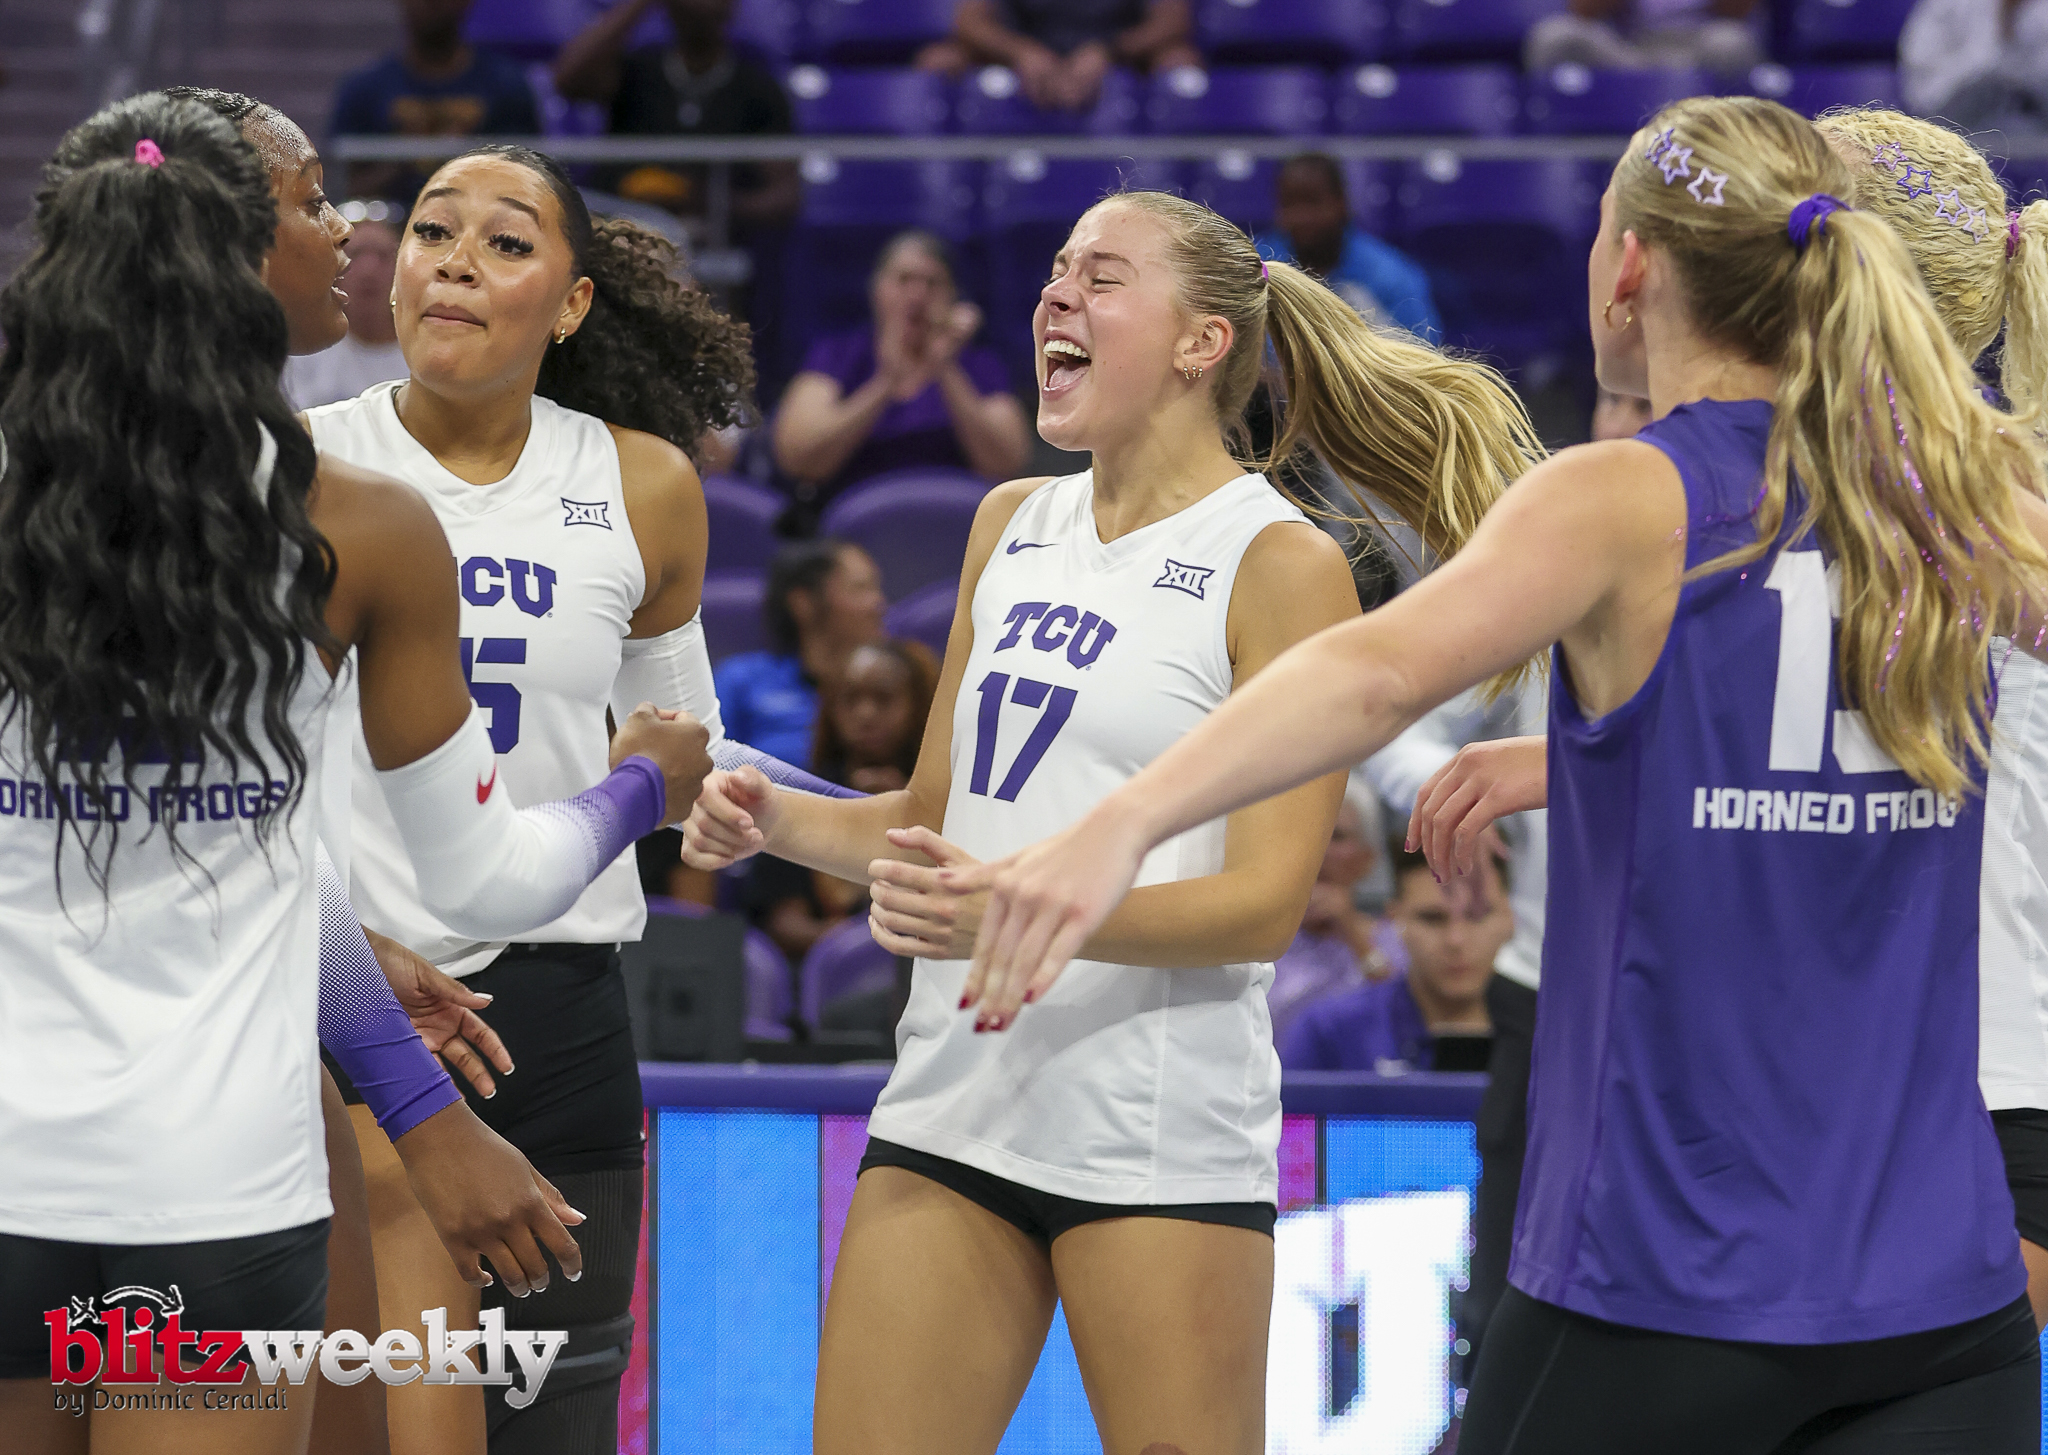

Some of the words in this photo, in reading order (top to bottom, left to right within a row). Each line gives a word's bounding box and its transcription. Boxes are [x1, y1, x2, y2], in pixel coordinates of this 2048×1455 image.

[454, 555, 558, 618] CU
[993, 602, 1118, 669] TCU
[969, 671, 1079, 803] 17
[1692, 786, 1856, 835] HORNED
